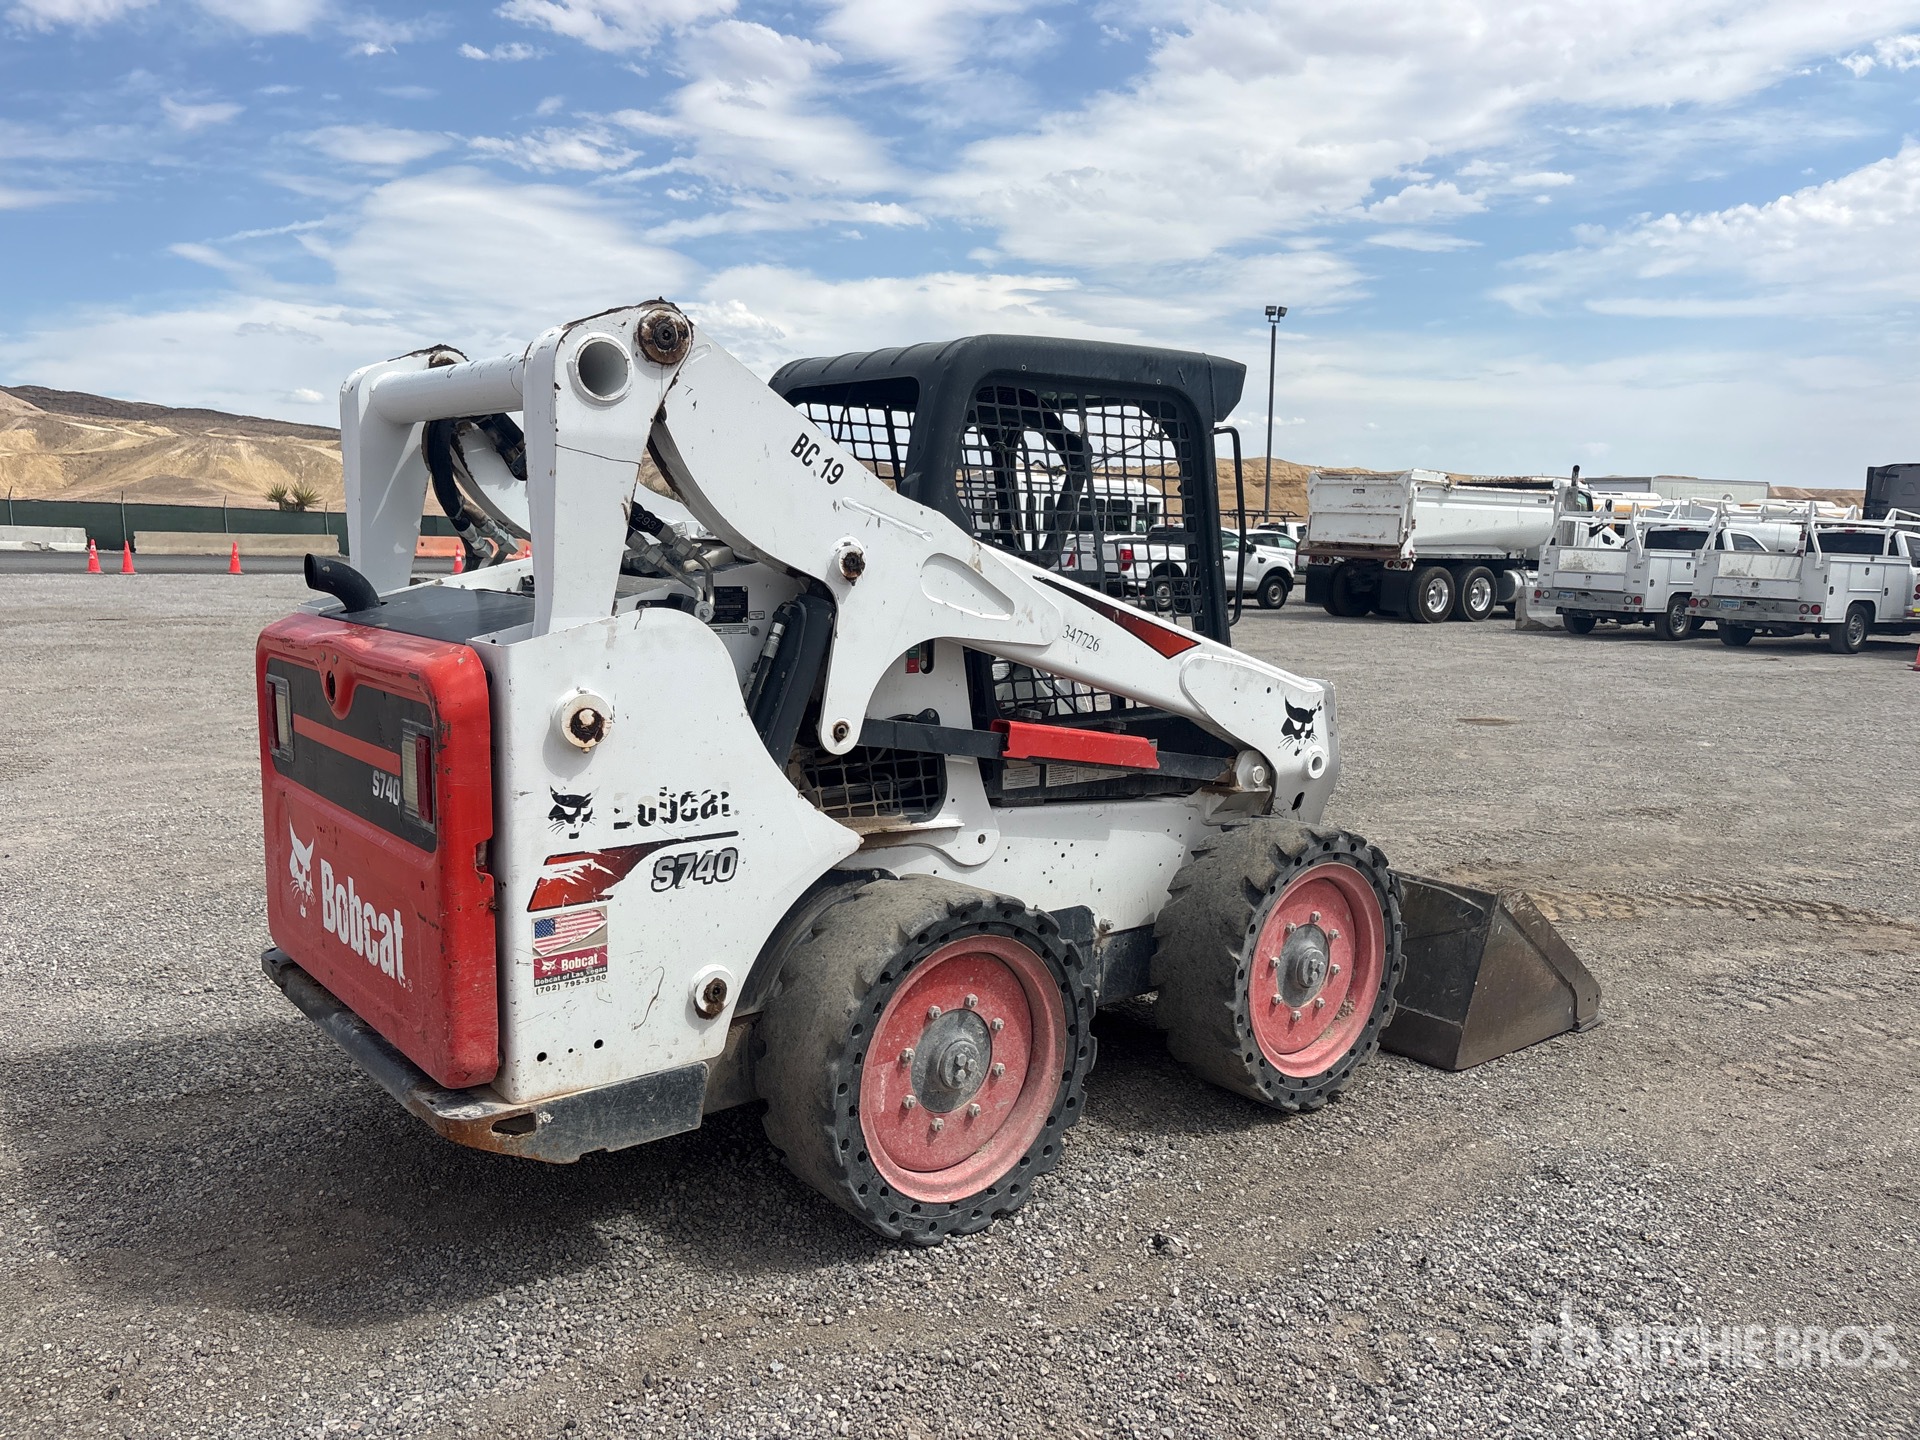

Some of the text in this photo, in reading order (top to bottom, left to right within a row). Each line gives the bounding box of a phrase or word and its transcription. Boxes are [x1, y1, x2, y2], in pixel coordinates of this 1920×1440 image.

[790, 432, 844, 485] BC 19
[1062, 624, 1101, 652] 347726
[372, 769, 400, 806] S740
[651, 847, 739, 892] S740
[536, 974, 607, 995] (702) 795-3300
